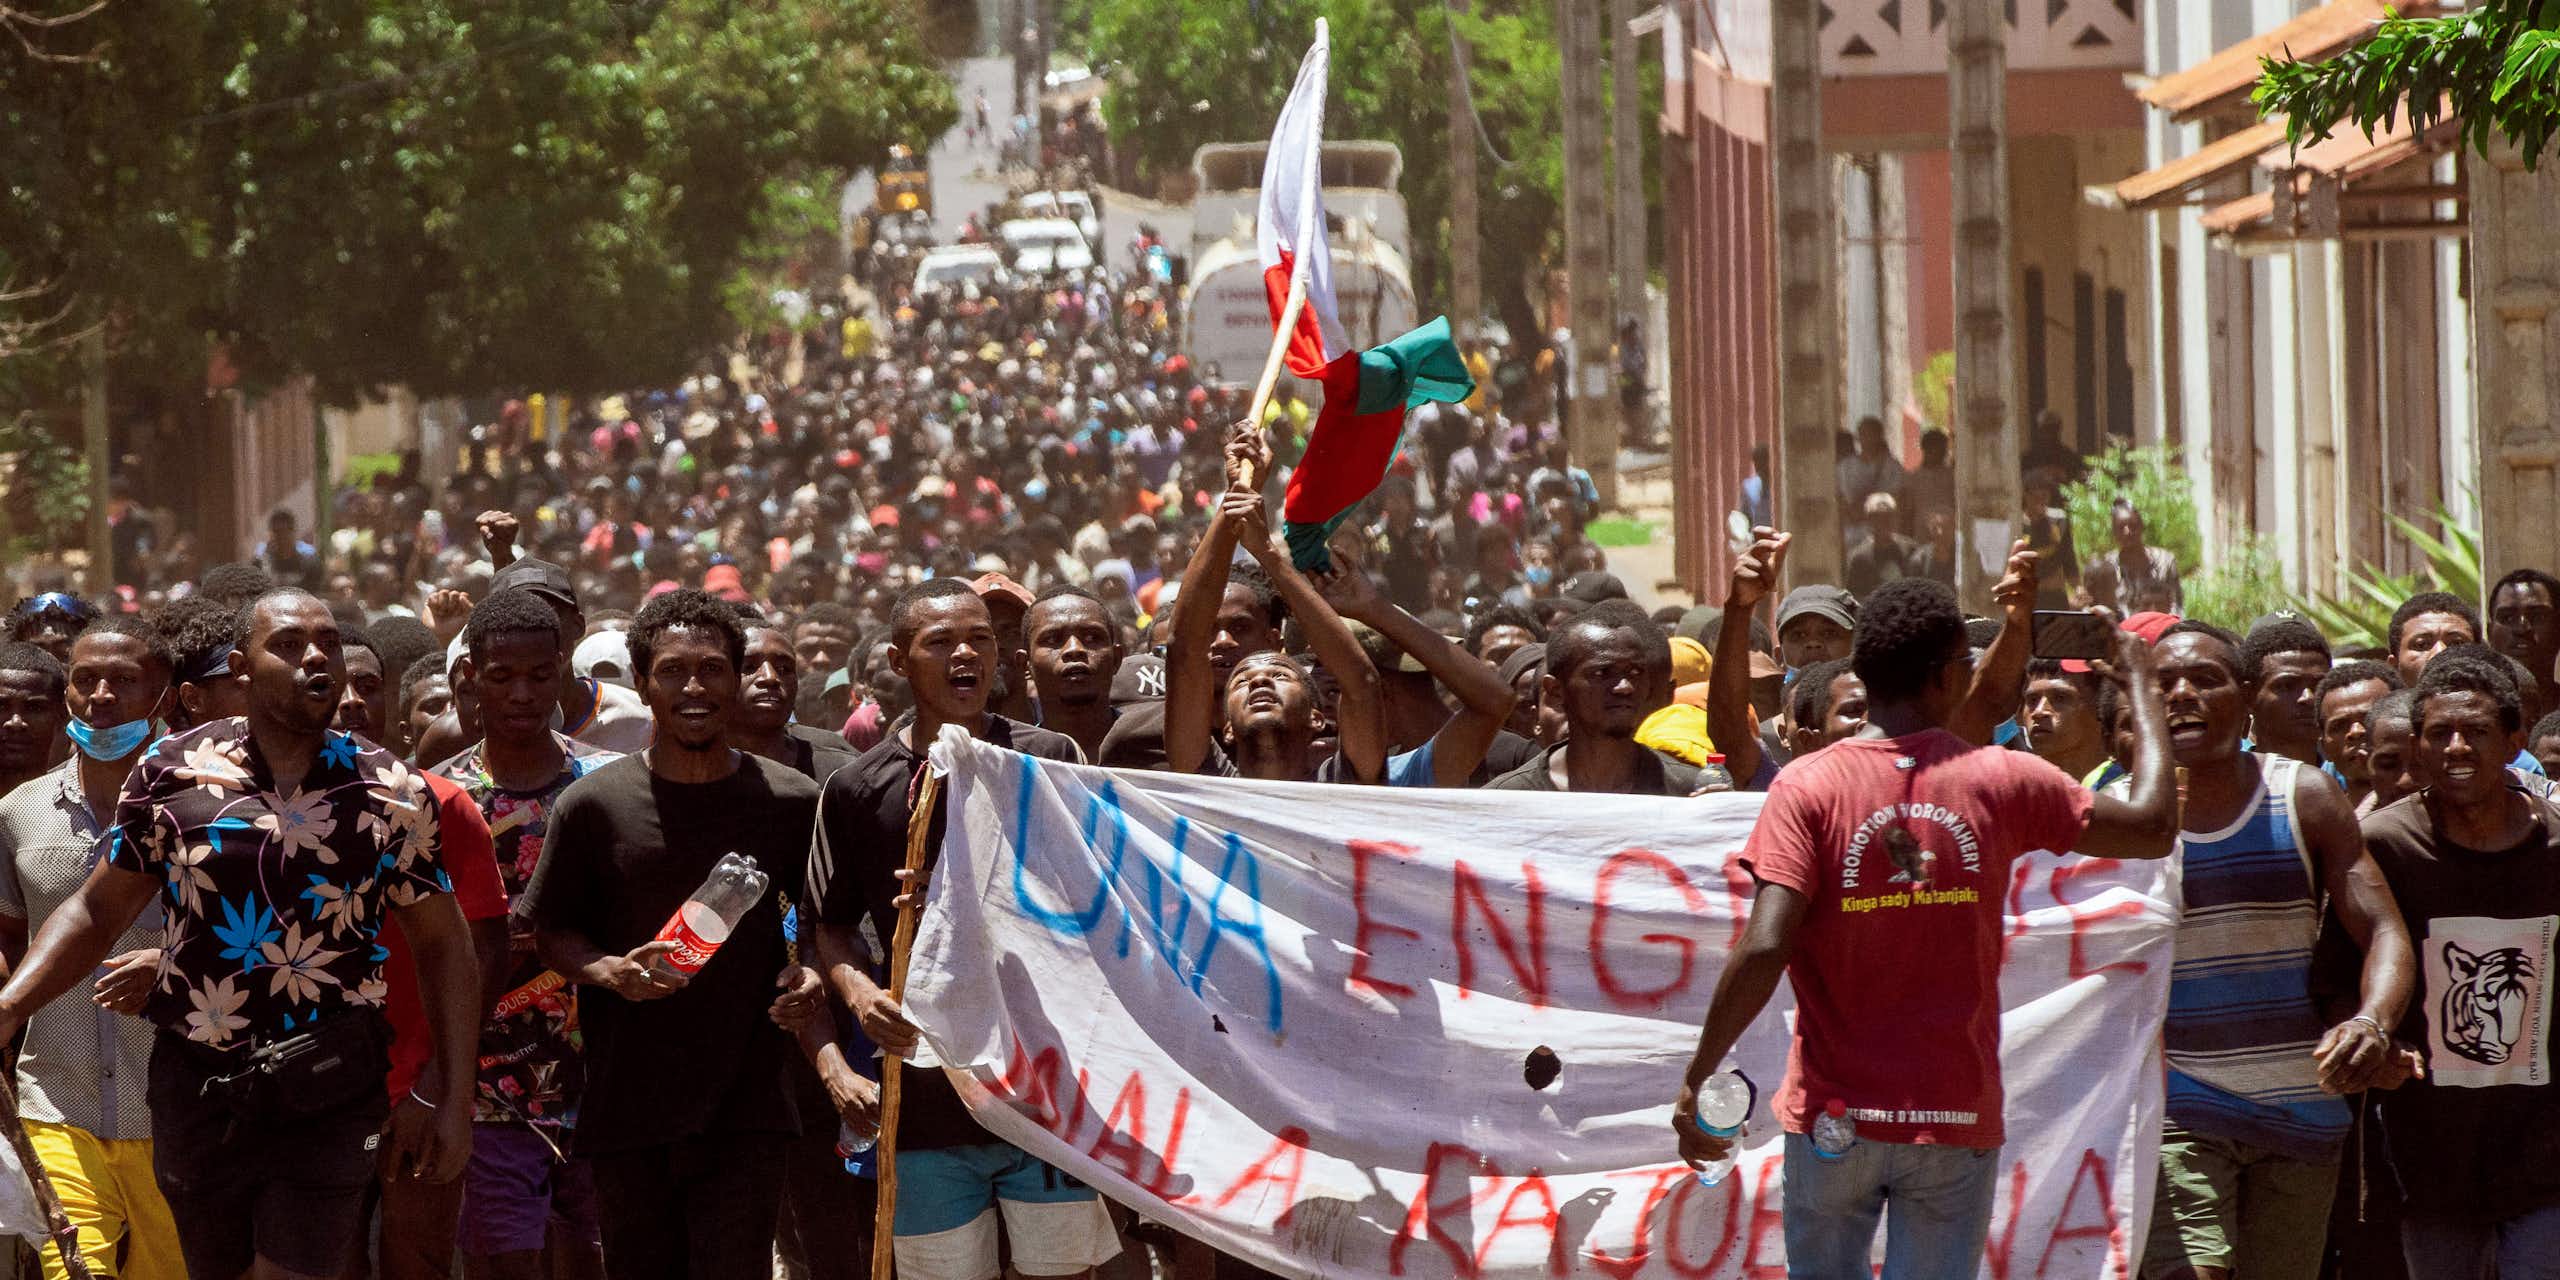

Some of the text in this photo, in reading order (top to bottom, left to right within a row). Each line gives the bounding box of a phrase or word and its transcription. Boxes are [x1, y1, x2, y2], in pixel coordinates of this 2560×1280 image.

[1842, 803, 1981, 888] PROMOTION VOROMAHERY
[1841, 887, 1979, 912] Kinga sady Matanjaka
[2531, 1015, 2542, 1037] YOU
